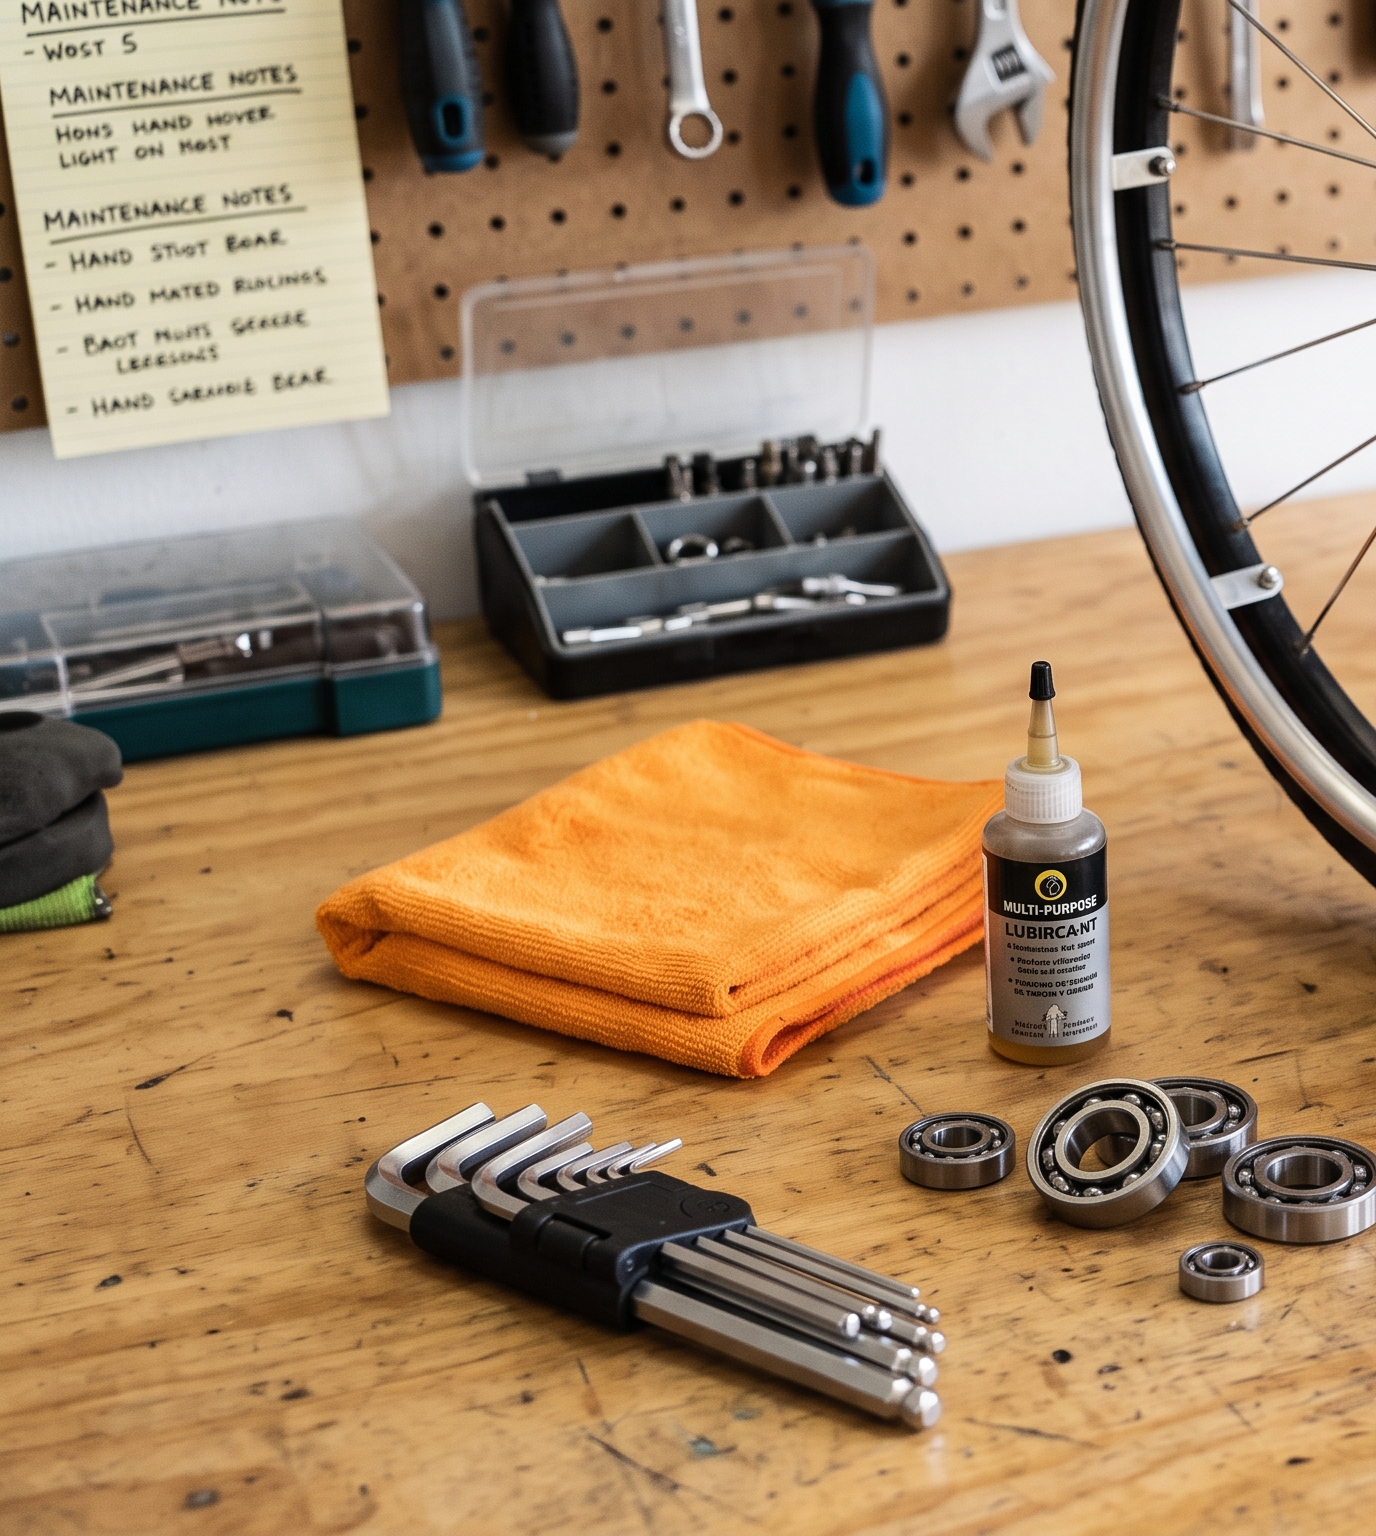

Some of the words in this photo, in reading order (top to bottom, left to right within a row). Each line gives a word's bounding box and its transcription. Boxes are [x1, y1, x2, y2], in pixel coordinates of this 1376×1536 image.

[50, 72, 214, 107] MAINTENANCE
[229, 64, 298, 88] NOTES
[132, 115, 192, 136] HAND
[59, 147, 118, 169] LIGHT
[135, 142, 164, 160] ON
[43, 195, 205, 231] MAINTENANCE
[222, 183, 292, 208] NOTES
[70, 248, 133, 272] HAND
[75, 290, 135, 314] HAND
[91, 393, 154, 417] HAND
[1003, 894, 1098, 916] MULTI-PURPOSE
